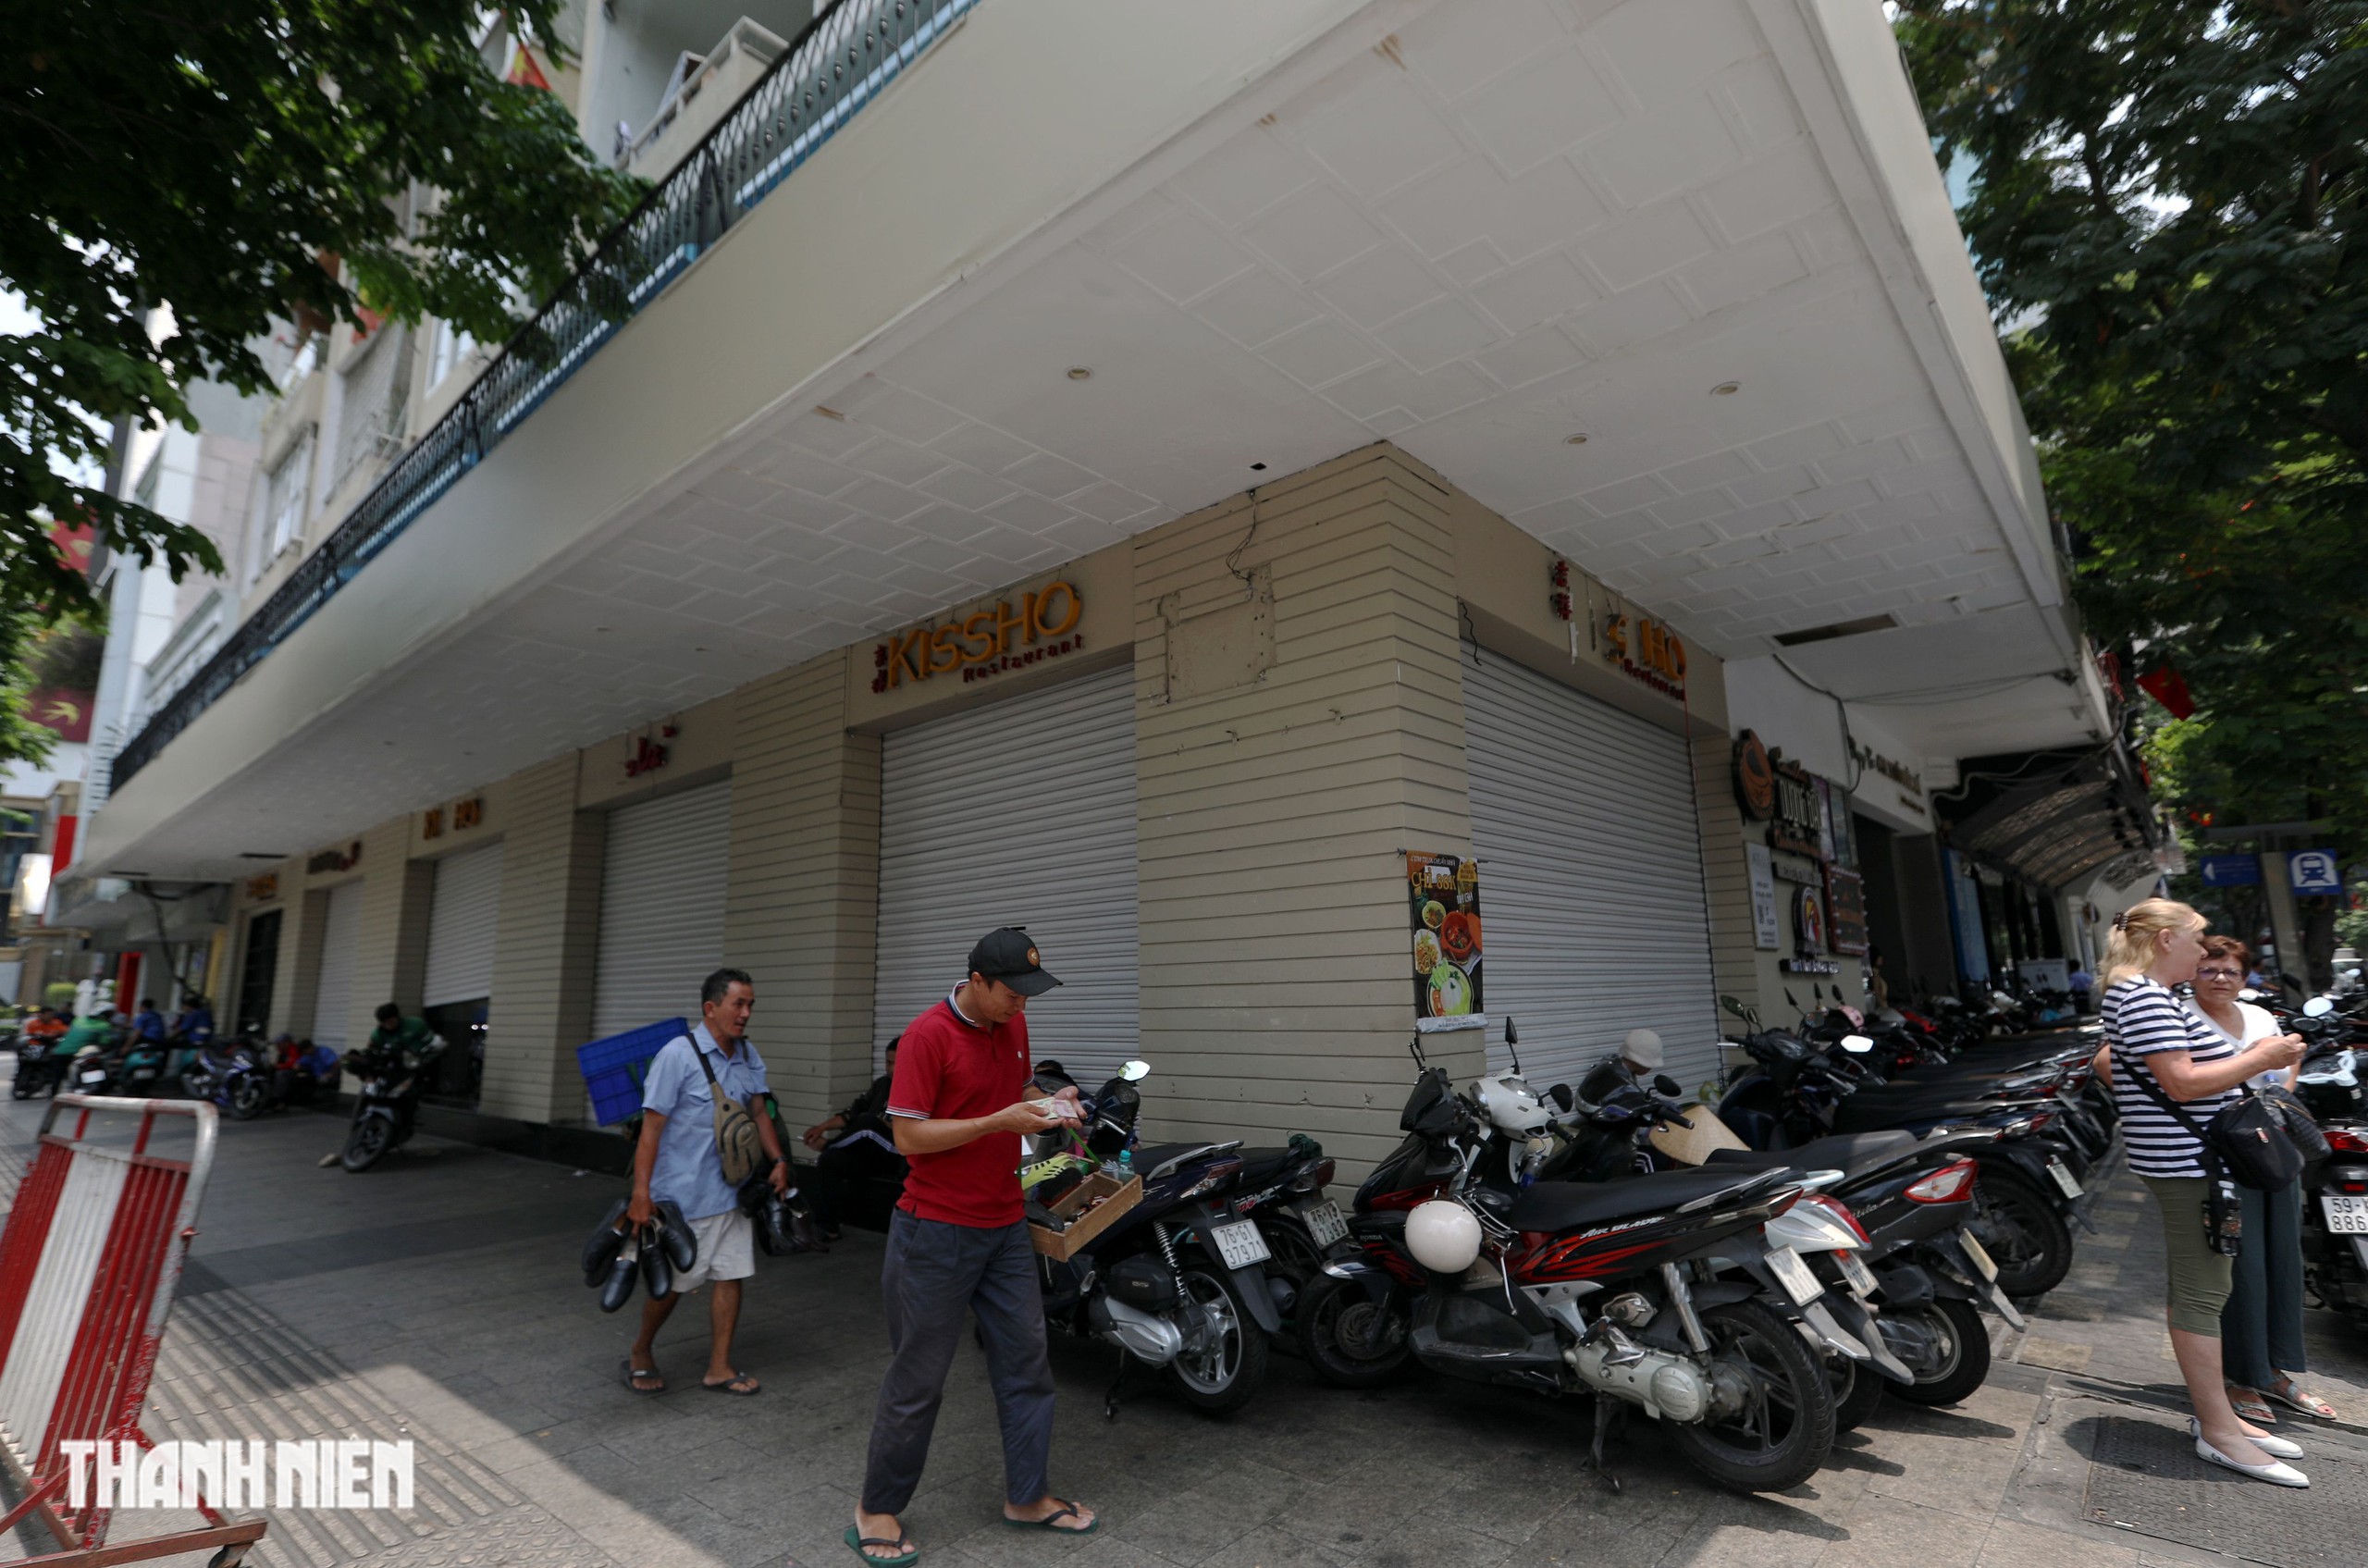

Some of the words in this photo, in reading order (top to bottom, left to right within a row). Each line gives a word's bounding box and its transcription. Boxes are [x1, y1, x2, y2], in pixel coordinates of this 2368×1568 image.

[887, 581, 1081, 689] KISSHO
[963, 634, 1082, 683] Restaurant
[1436, 873, 1457, 891] 88K
